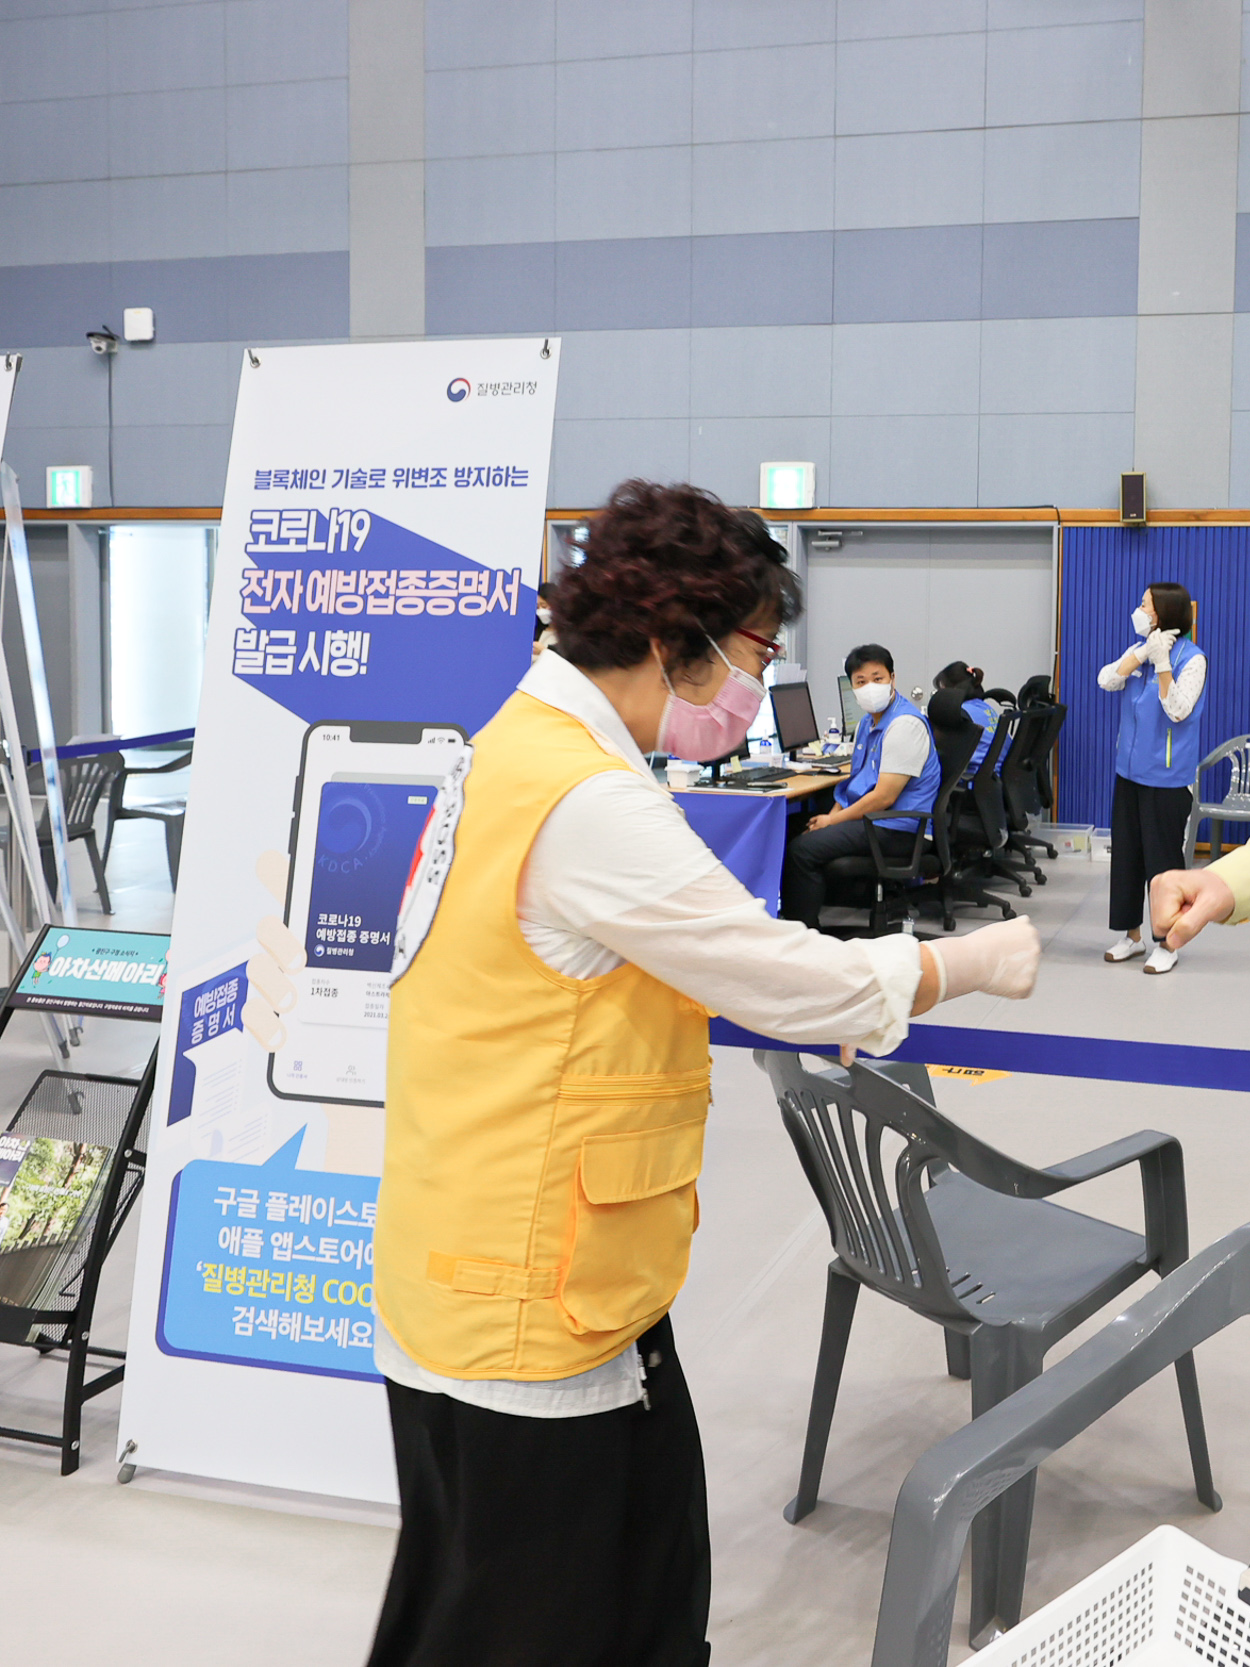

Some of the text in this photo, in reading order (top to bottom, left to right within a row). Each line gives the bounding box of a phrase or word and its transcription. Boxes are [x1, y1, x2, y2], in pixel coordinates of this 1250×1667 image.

[477, 381, 538, 397] 질병관리청
[254, 466, 529, 491] 블록체인 기술로 위변조 방지하는
[245, 508, 371, 554] 코로나19
[240, 567, 523, 617] 전자 예방접종증명서
[233, 627, 371, 678] 발급 시행!
[317, 854, 363, 874] KDCA
[317, 913, 362, 927] 코로나19
[316, 928, 391, 945] 예방접종 증명서
[326, 946, 354, 957] 질병관리청
[48, 956, 165, 986] 아차산메아리
[194, 977, 239, 1019] 예방접종
[311, 987, 338, 998] 1차접종
[214, 1186, 260, 1219] 구글
[218, 1226, 374, 1270] 애플 앱스토어
[232, 1306, 373, 1349] 검색해보세요
